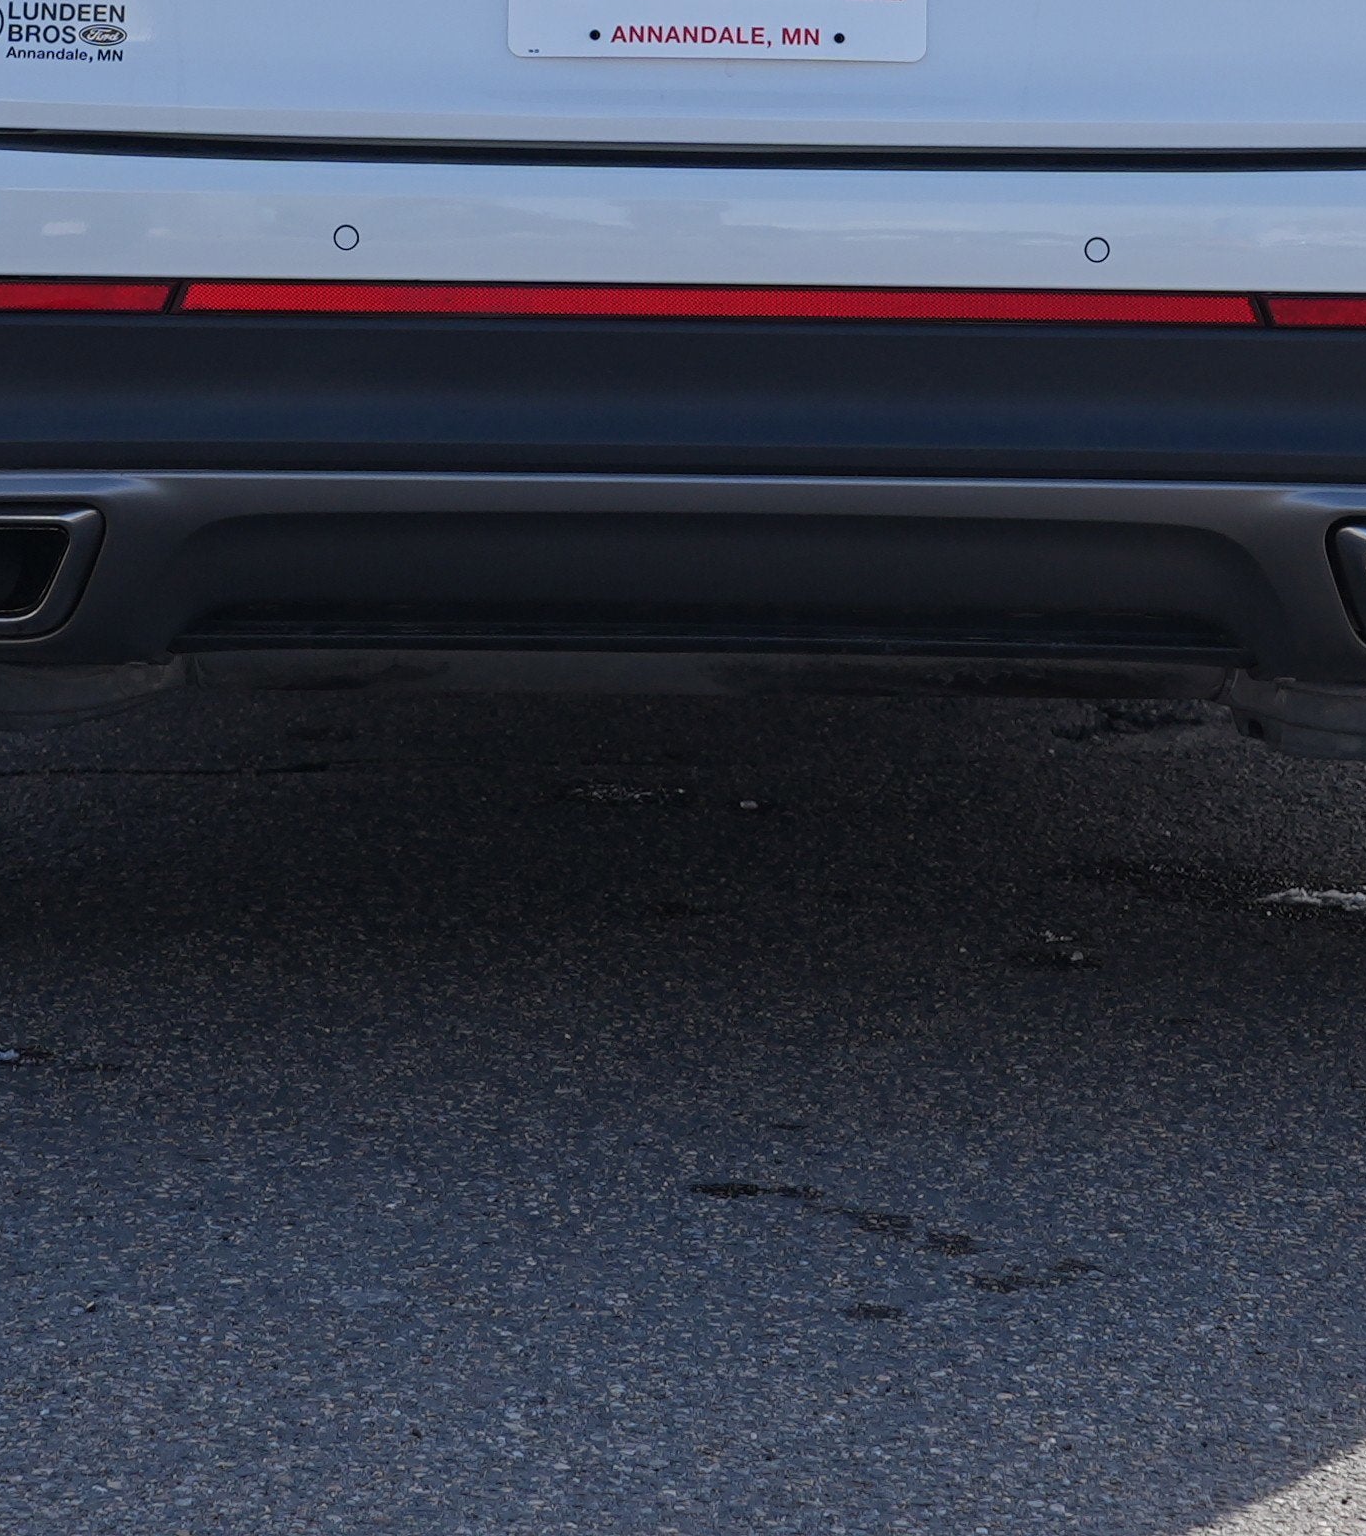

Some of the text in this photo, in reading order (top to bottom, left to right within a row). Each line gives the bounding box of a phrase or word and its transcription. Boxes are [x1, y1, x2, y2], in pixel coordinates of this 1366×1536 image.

[8, 2, 126, 23] LUNDEEN
[8, 24, 77, 44] BROS
[87, 29, 121, 41] Ford
[611, 25, 820, 47] ANNANDALE, MN
[6, 46, 123, 63] Annandale, MN
